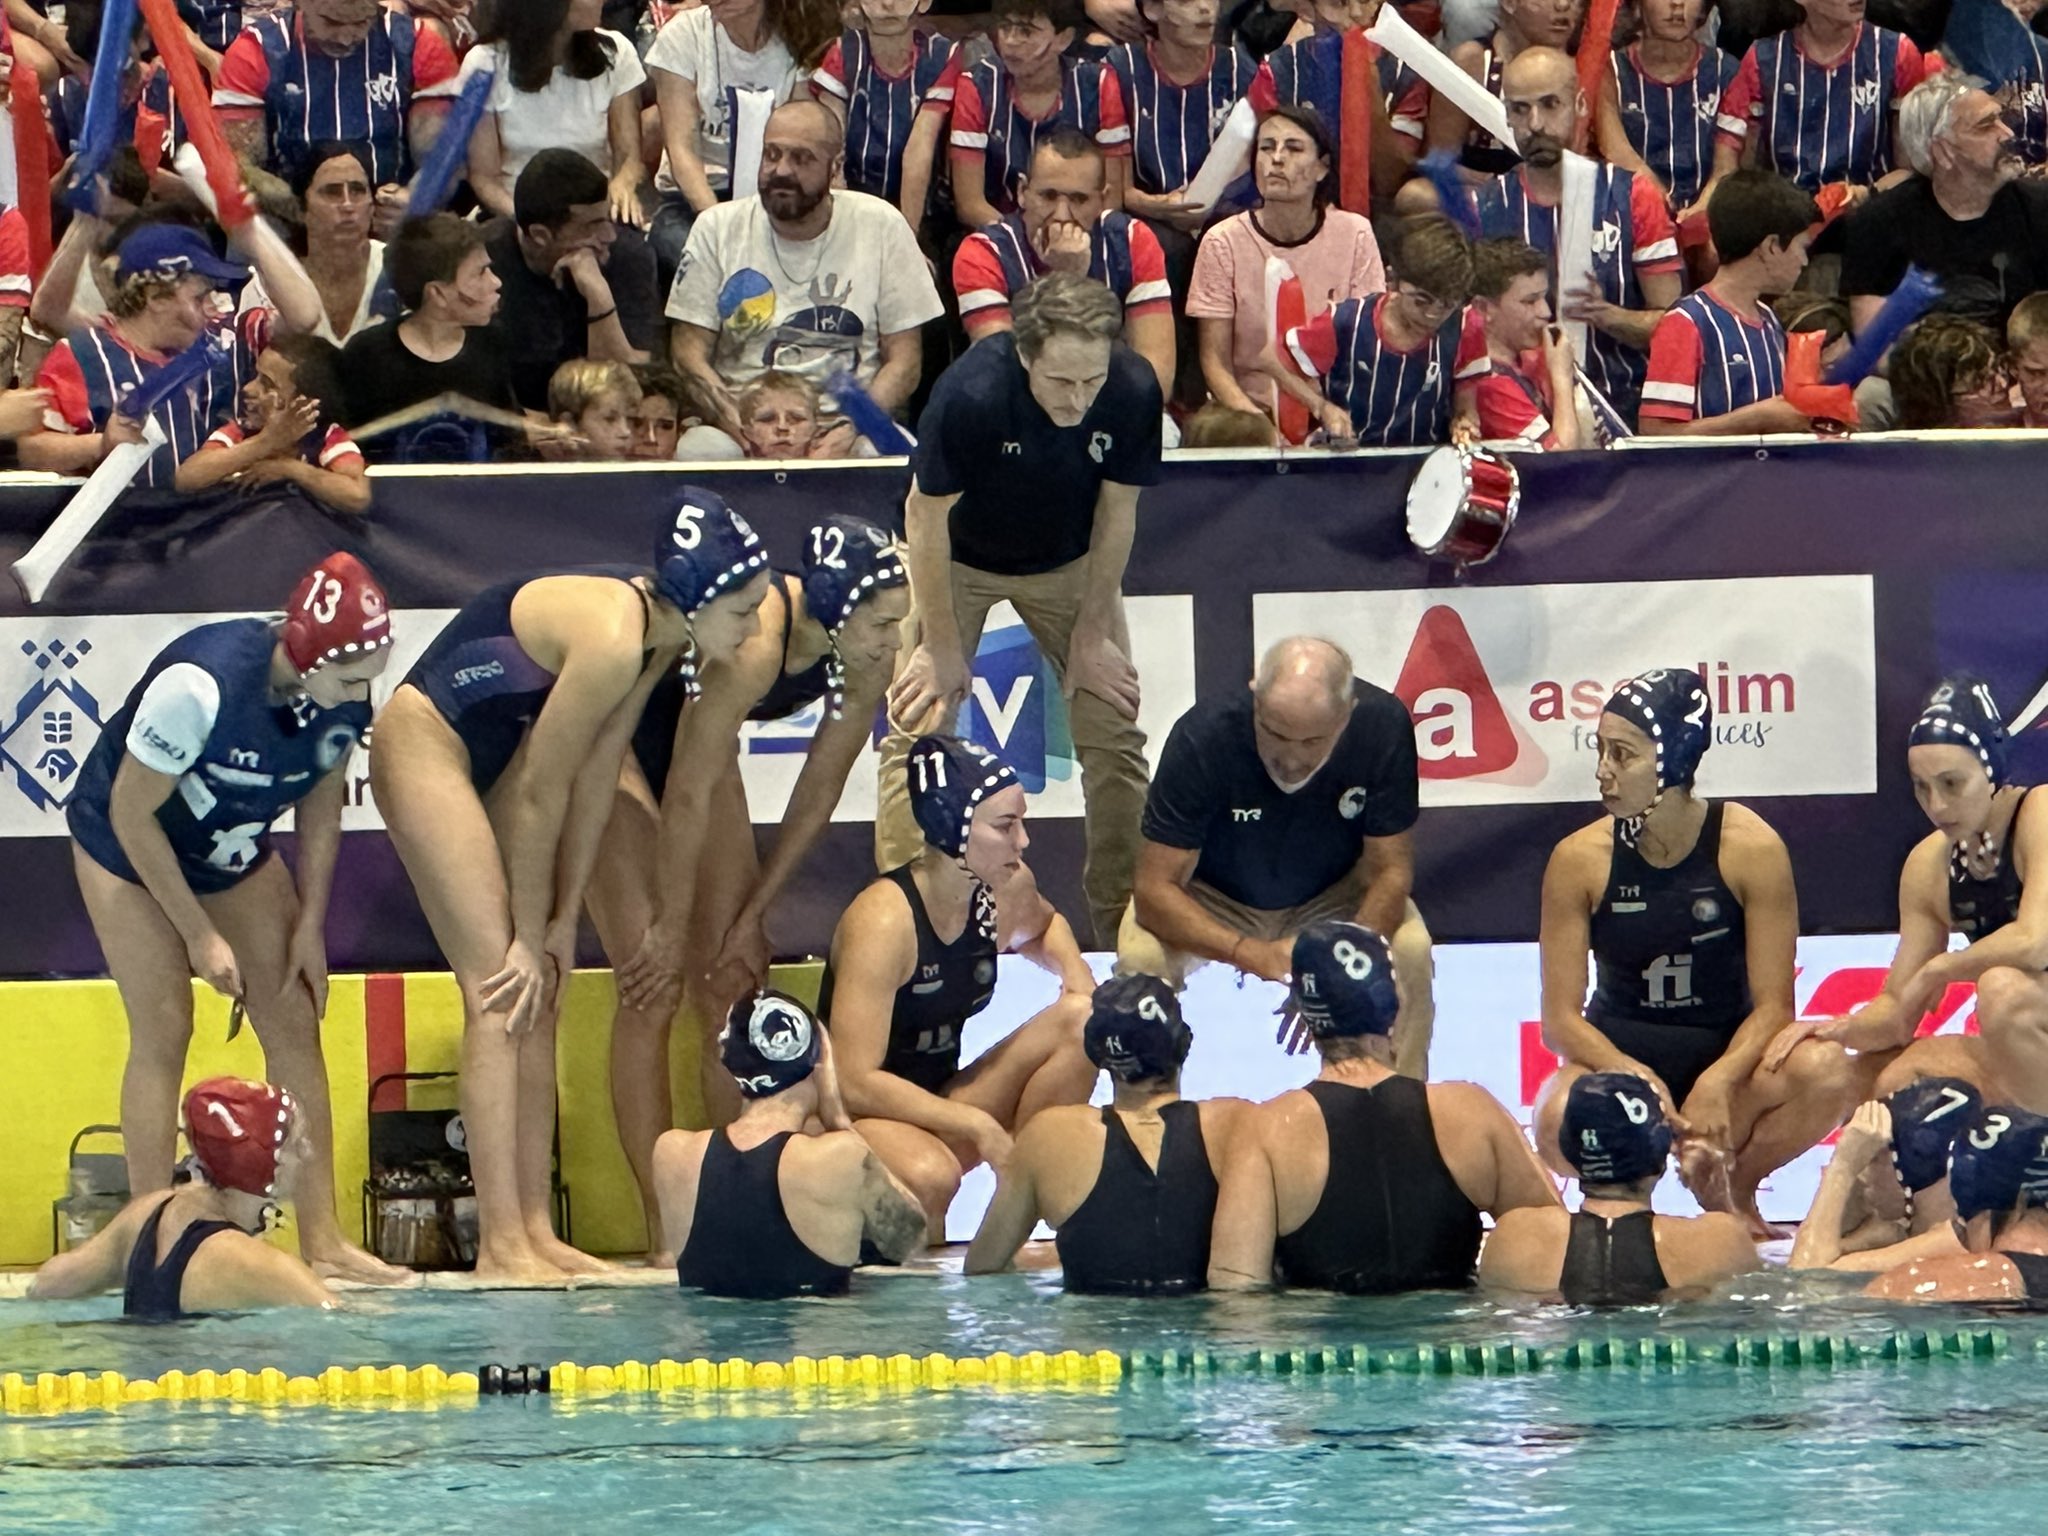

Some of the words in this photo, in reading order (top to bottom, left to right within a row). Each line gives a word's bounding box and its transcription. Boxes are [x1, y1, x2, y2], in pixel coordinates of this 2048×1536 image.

[672, 504, 706, 551] 5
[810, 525, 848, 570] 12
[302, 569, 343, 624] 13
[1412, 686, 1479, 762] a
[1683, 688, 1709, 732] 2
[912, 751, 948, 793] 11
[1332, 939, 1373, 981] 8
[1137, 996, 1169, 1024] 9
[1614, 1091, 1649, 1125] 6
[1921, 1086, 1970, 1124] 7
[1968, 1113, 2012, 1150] 3
